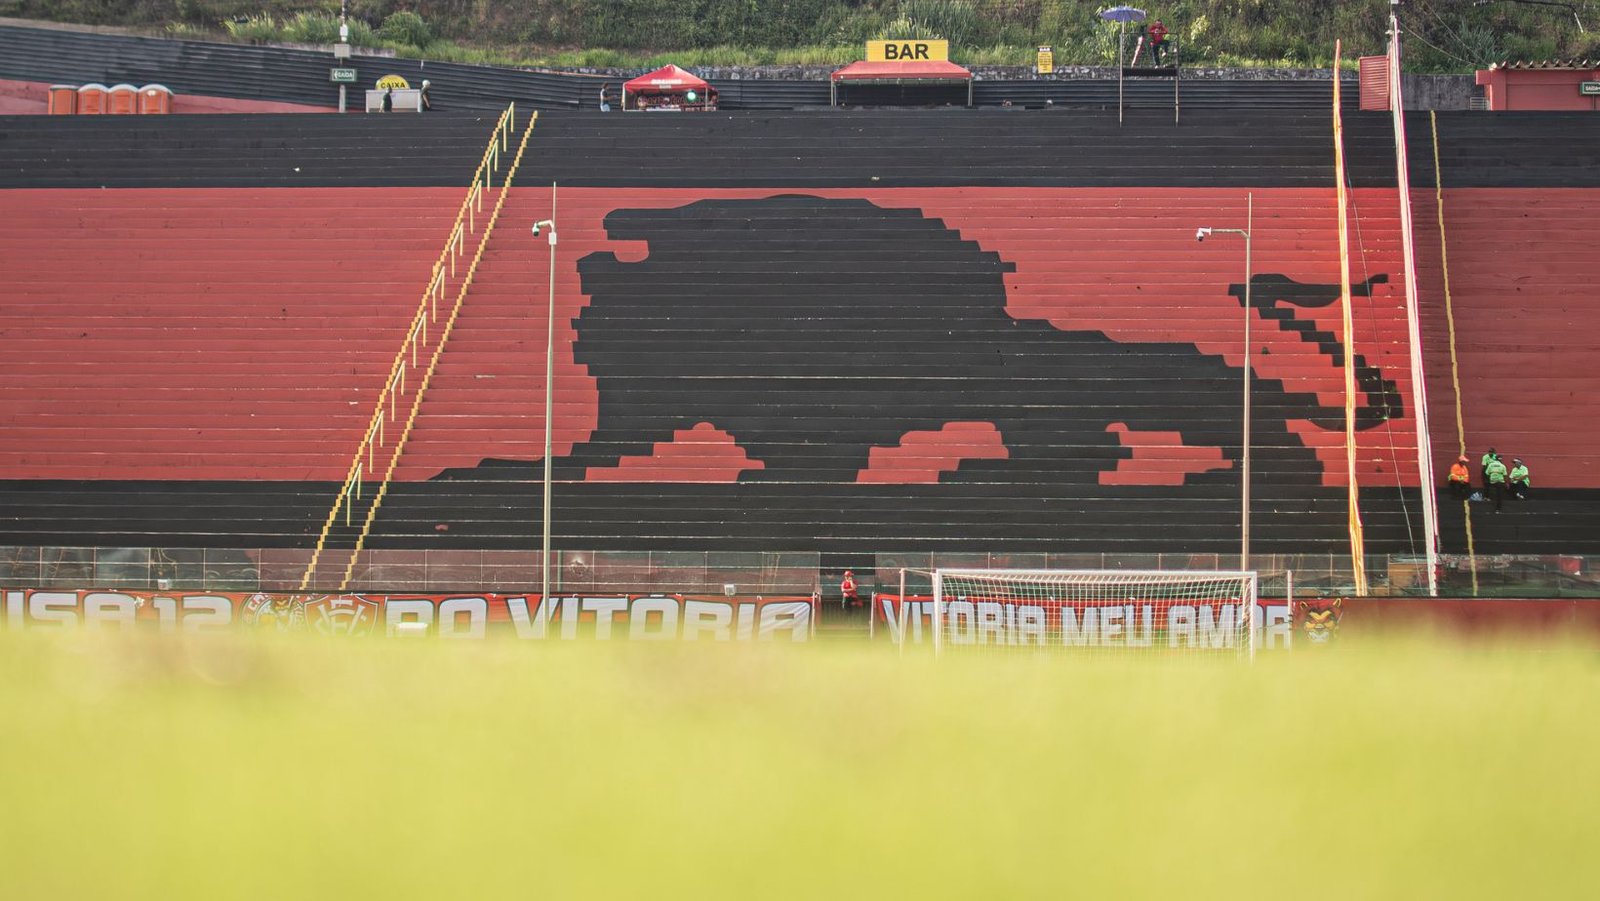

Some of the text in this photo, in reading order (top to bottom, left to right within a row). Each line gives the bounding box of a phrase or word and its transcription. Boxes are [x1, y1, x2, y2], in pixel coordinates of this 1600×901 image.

[884, 43, 929, 60] BAR
[1061, 604, 1150, 646] MEU
[1168, 604, 1291, 649] AMOR
